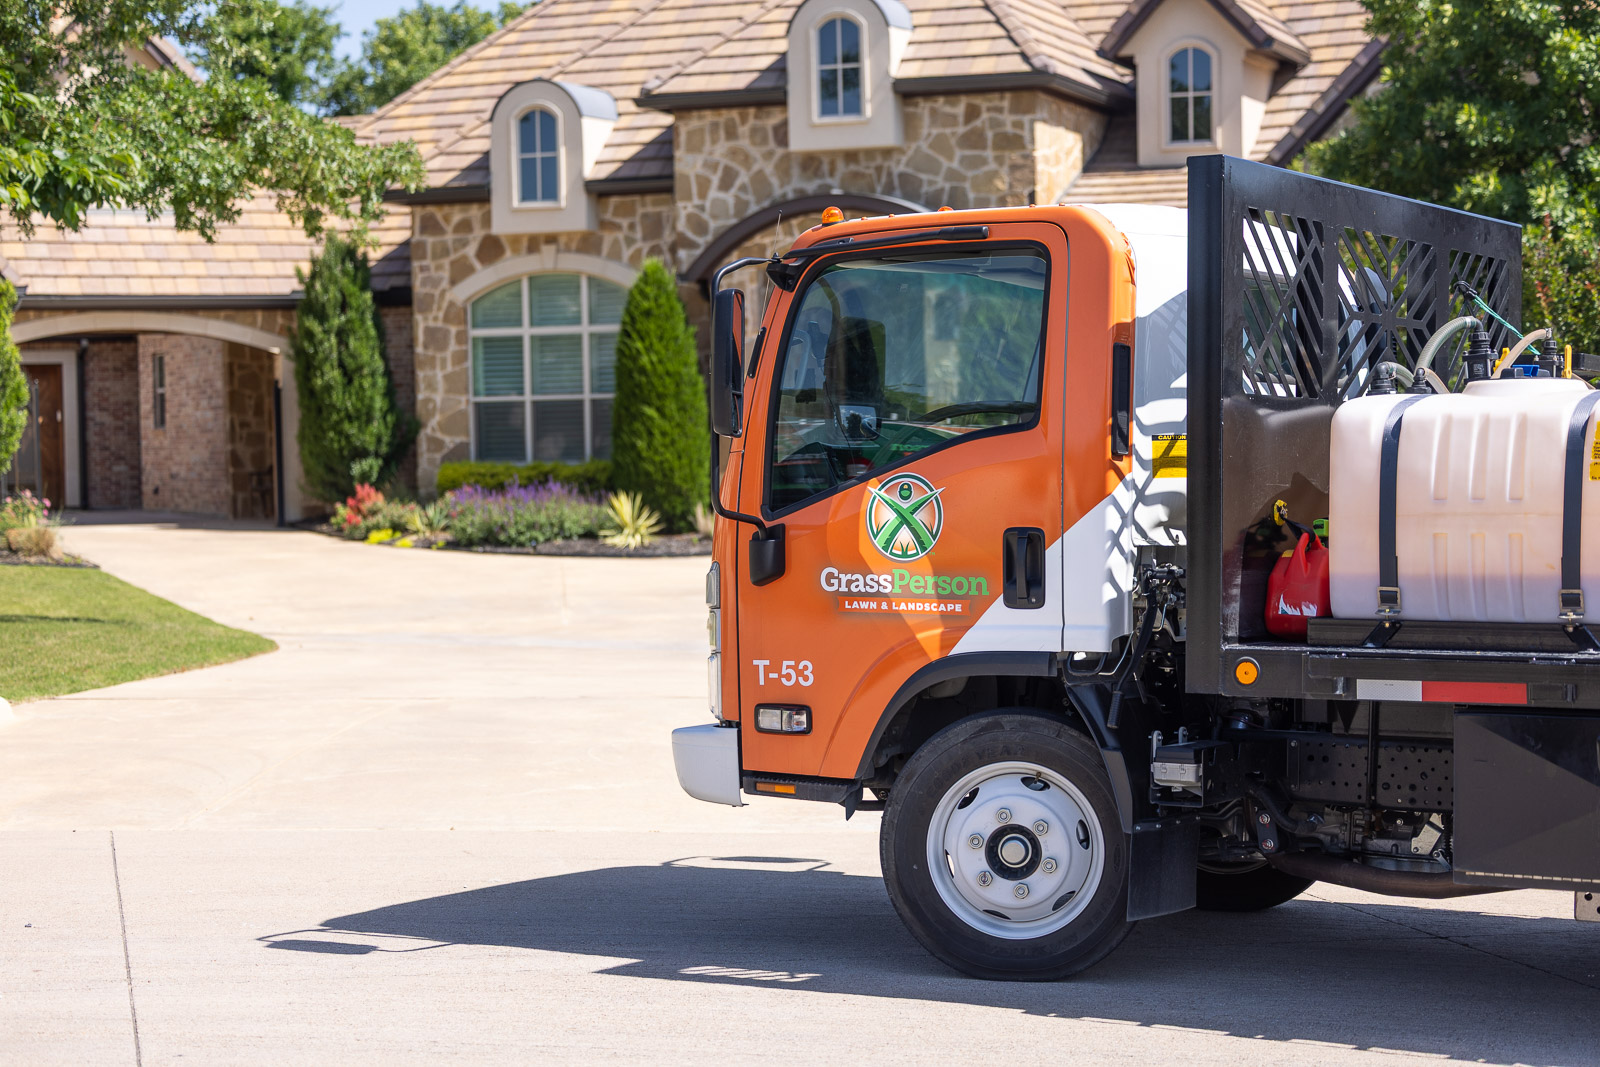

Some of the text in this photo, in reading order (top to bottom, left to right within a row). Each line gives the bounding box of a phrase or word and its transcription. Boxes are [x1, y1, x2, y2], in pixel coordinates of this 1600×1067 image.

[820, 566, 989, 596] GrassPerson
[844, 600, 963, 612] LAWN & LANDSCAPE
[752, 659, 814, 687] T-53
